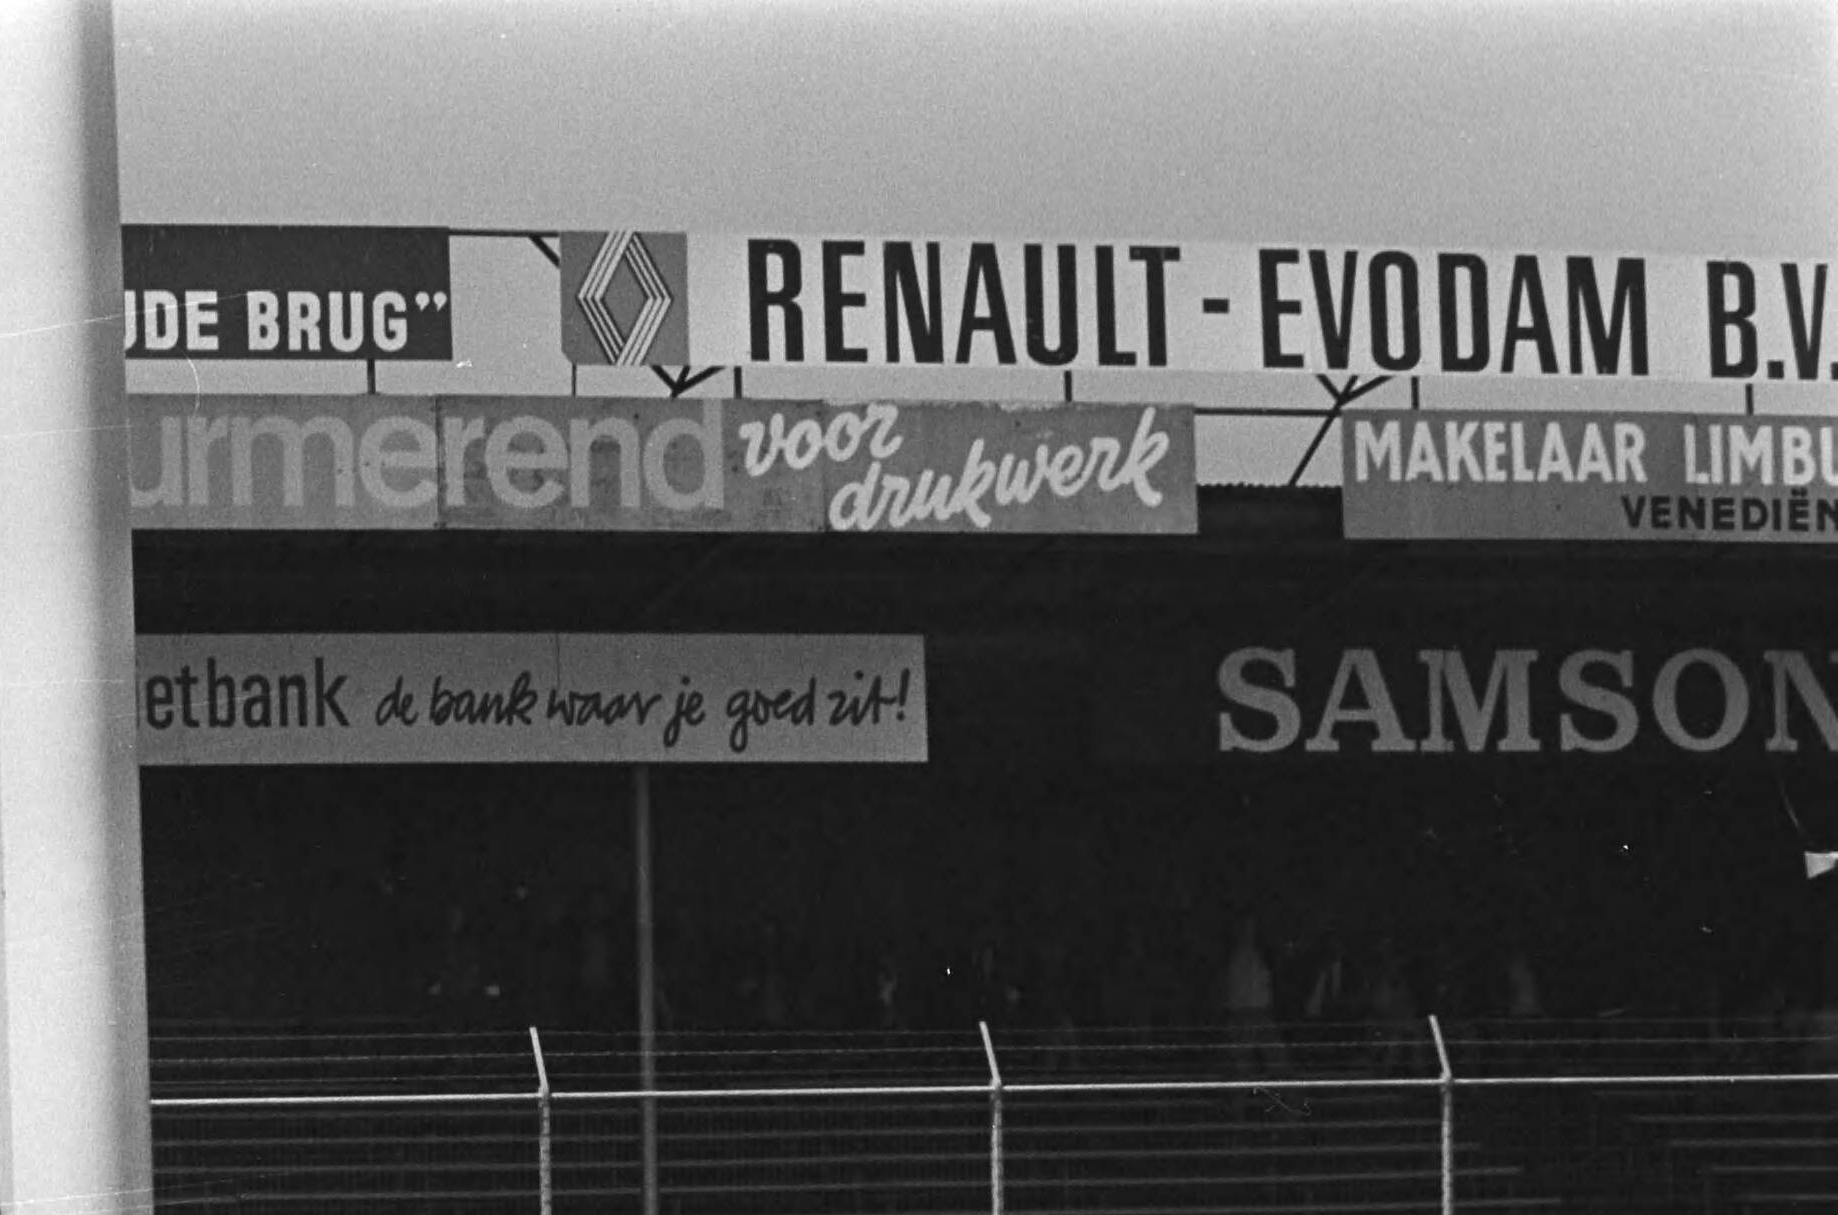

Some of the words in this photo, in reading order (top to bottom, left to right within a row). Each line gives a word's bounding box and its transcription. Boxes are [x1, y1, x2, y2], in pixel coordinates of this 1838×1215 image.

[747, 239, 1181, 367] RENAULT
[1259, 249, 1650, 376] EVODAM
[129, 396, 724, 509] urmerend
[738, 403, 903, 477] voor
[828, 406, 1170, 532] drukwerk
[1355, 420, 1647, 484] MAKELAAR
[137, 656, 351, 731] etbank
[375, 674, 419, 727] de
[428, 669, 539, 727] bank
[546, 686, 662, 727] waar
[663, 675, 707, 749] je
[725, 675, 817, 754] goed
[826, 668, 911, 727] zit!
[1216, 646, 1838, 753] SAMSON
